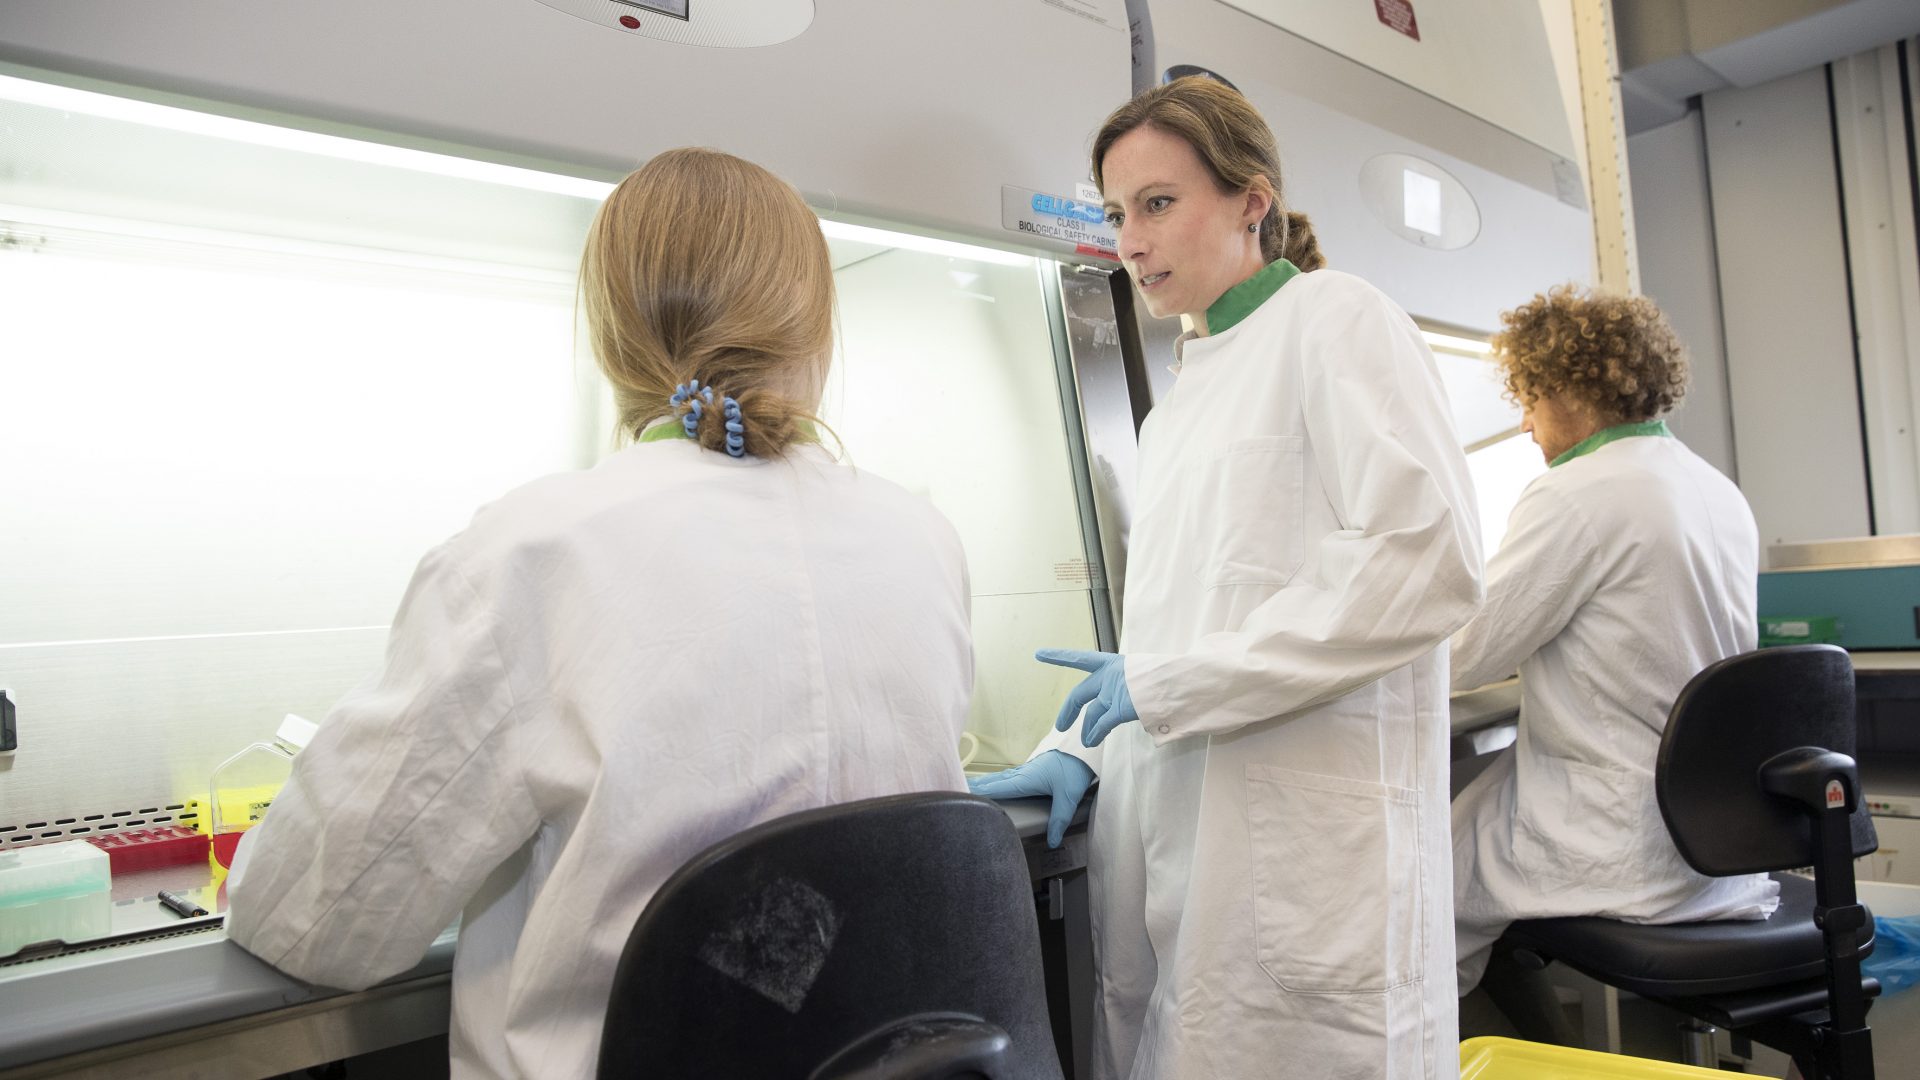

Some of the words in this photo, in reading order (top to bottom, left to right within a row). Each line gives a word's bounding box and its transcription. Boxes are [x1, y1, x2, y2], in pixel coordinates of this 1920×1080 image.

[1019, 220, 1061, 236] BIOLOGICAL
[1064, 230, 1090, 242] SAFETY
[1091, 235, 1117, 248] CABINE
[1057, 217, 1080, 231] CLASS
